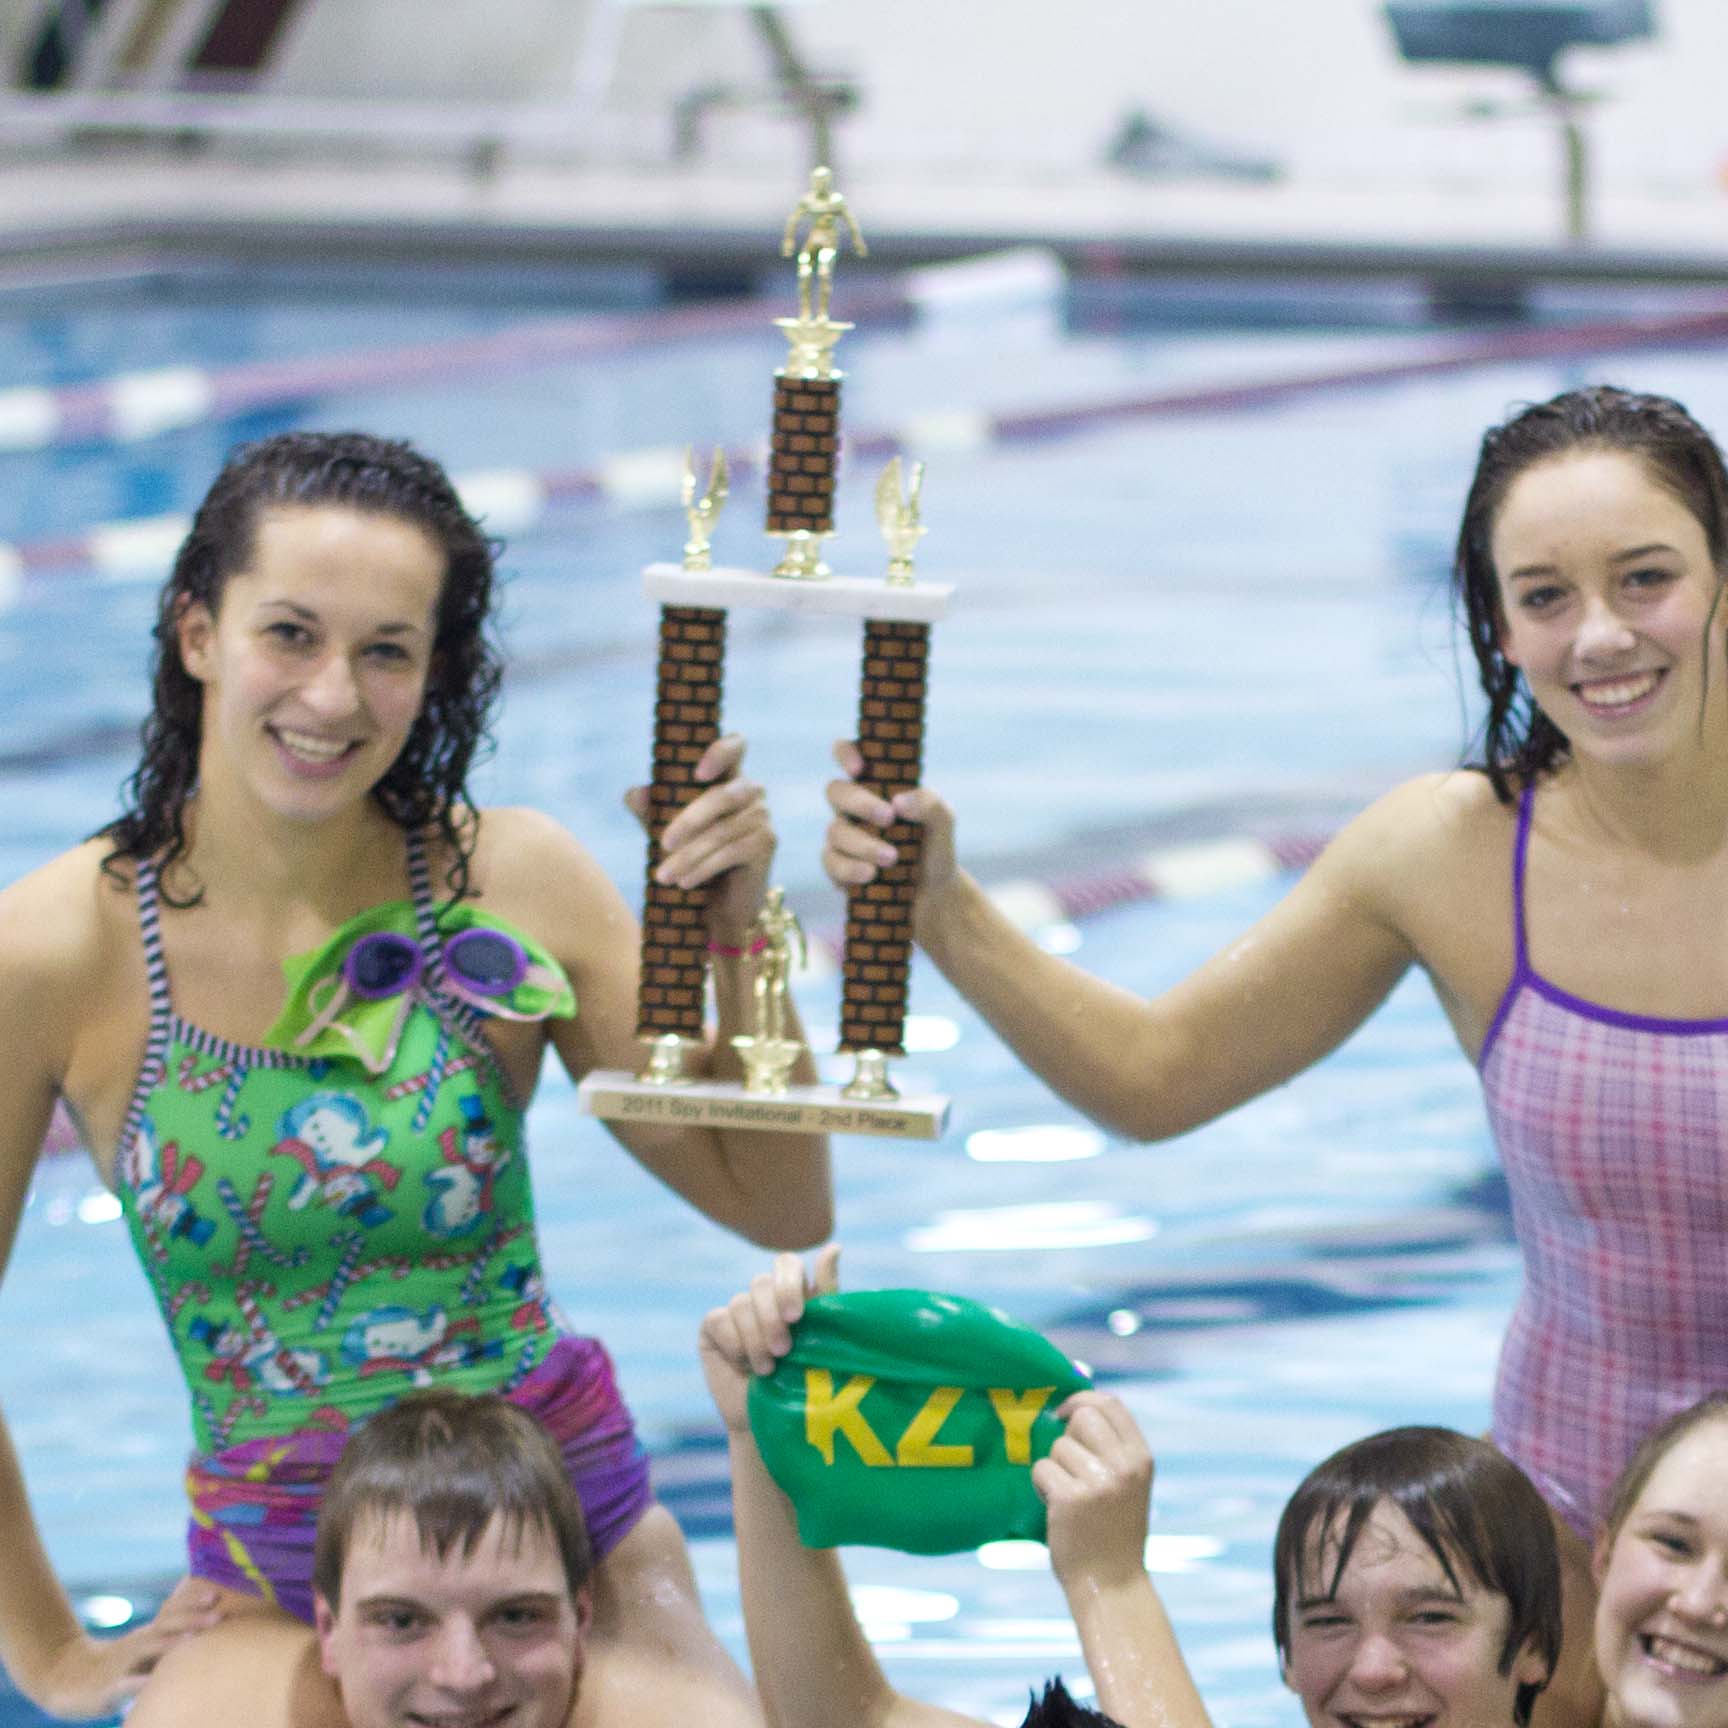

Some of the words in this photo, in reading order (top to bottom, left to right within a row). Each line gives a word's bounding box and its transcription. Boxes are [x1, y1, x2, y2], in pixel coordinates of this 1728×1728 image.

[708, 1103, 803, 1124] Invitational
[819, 1111, 852, 1129] 2nd
[857, 1113, 908, 1132] Place
[805, 1367, 1057, 1467] KZY
